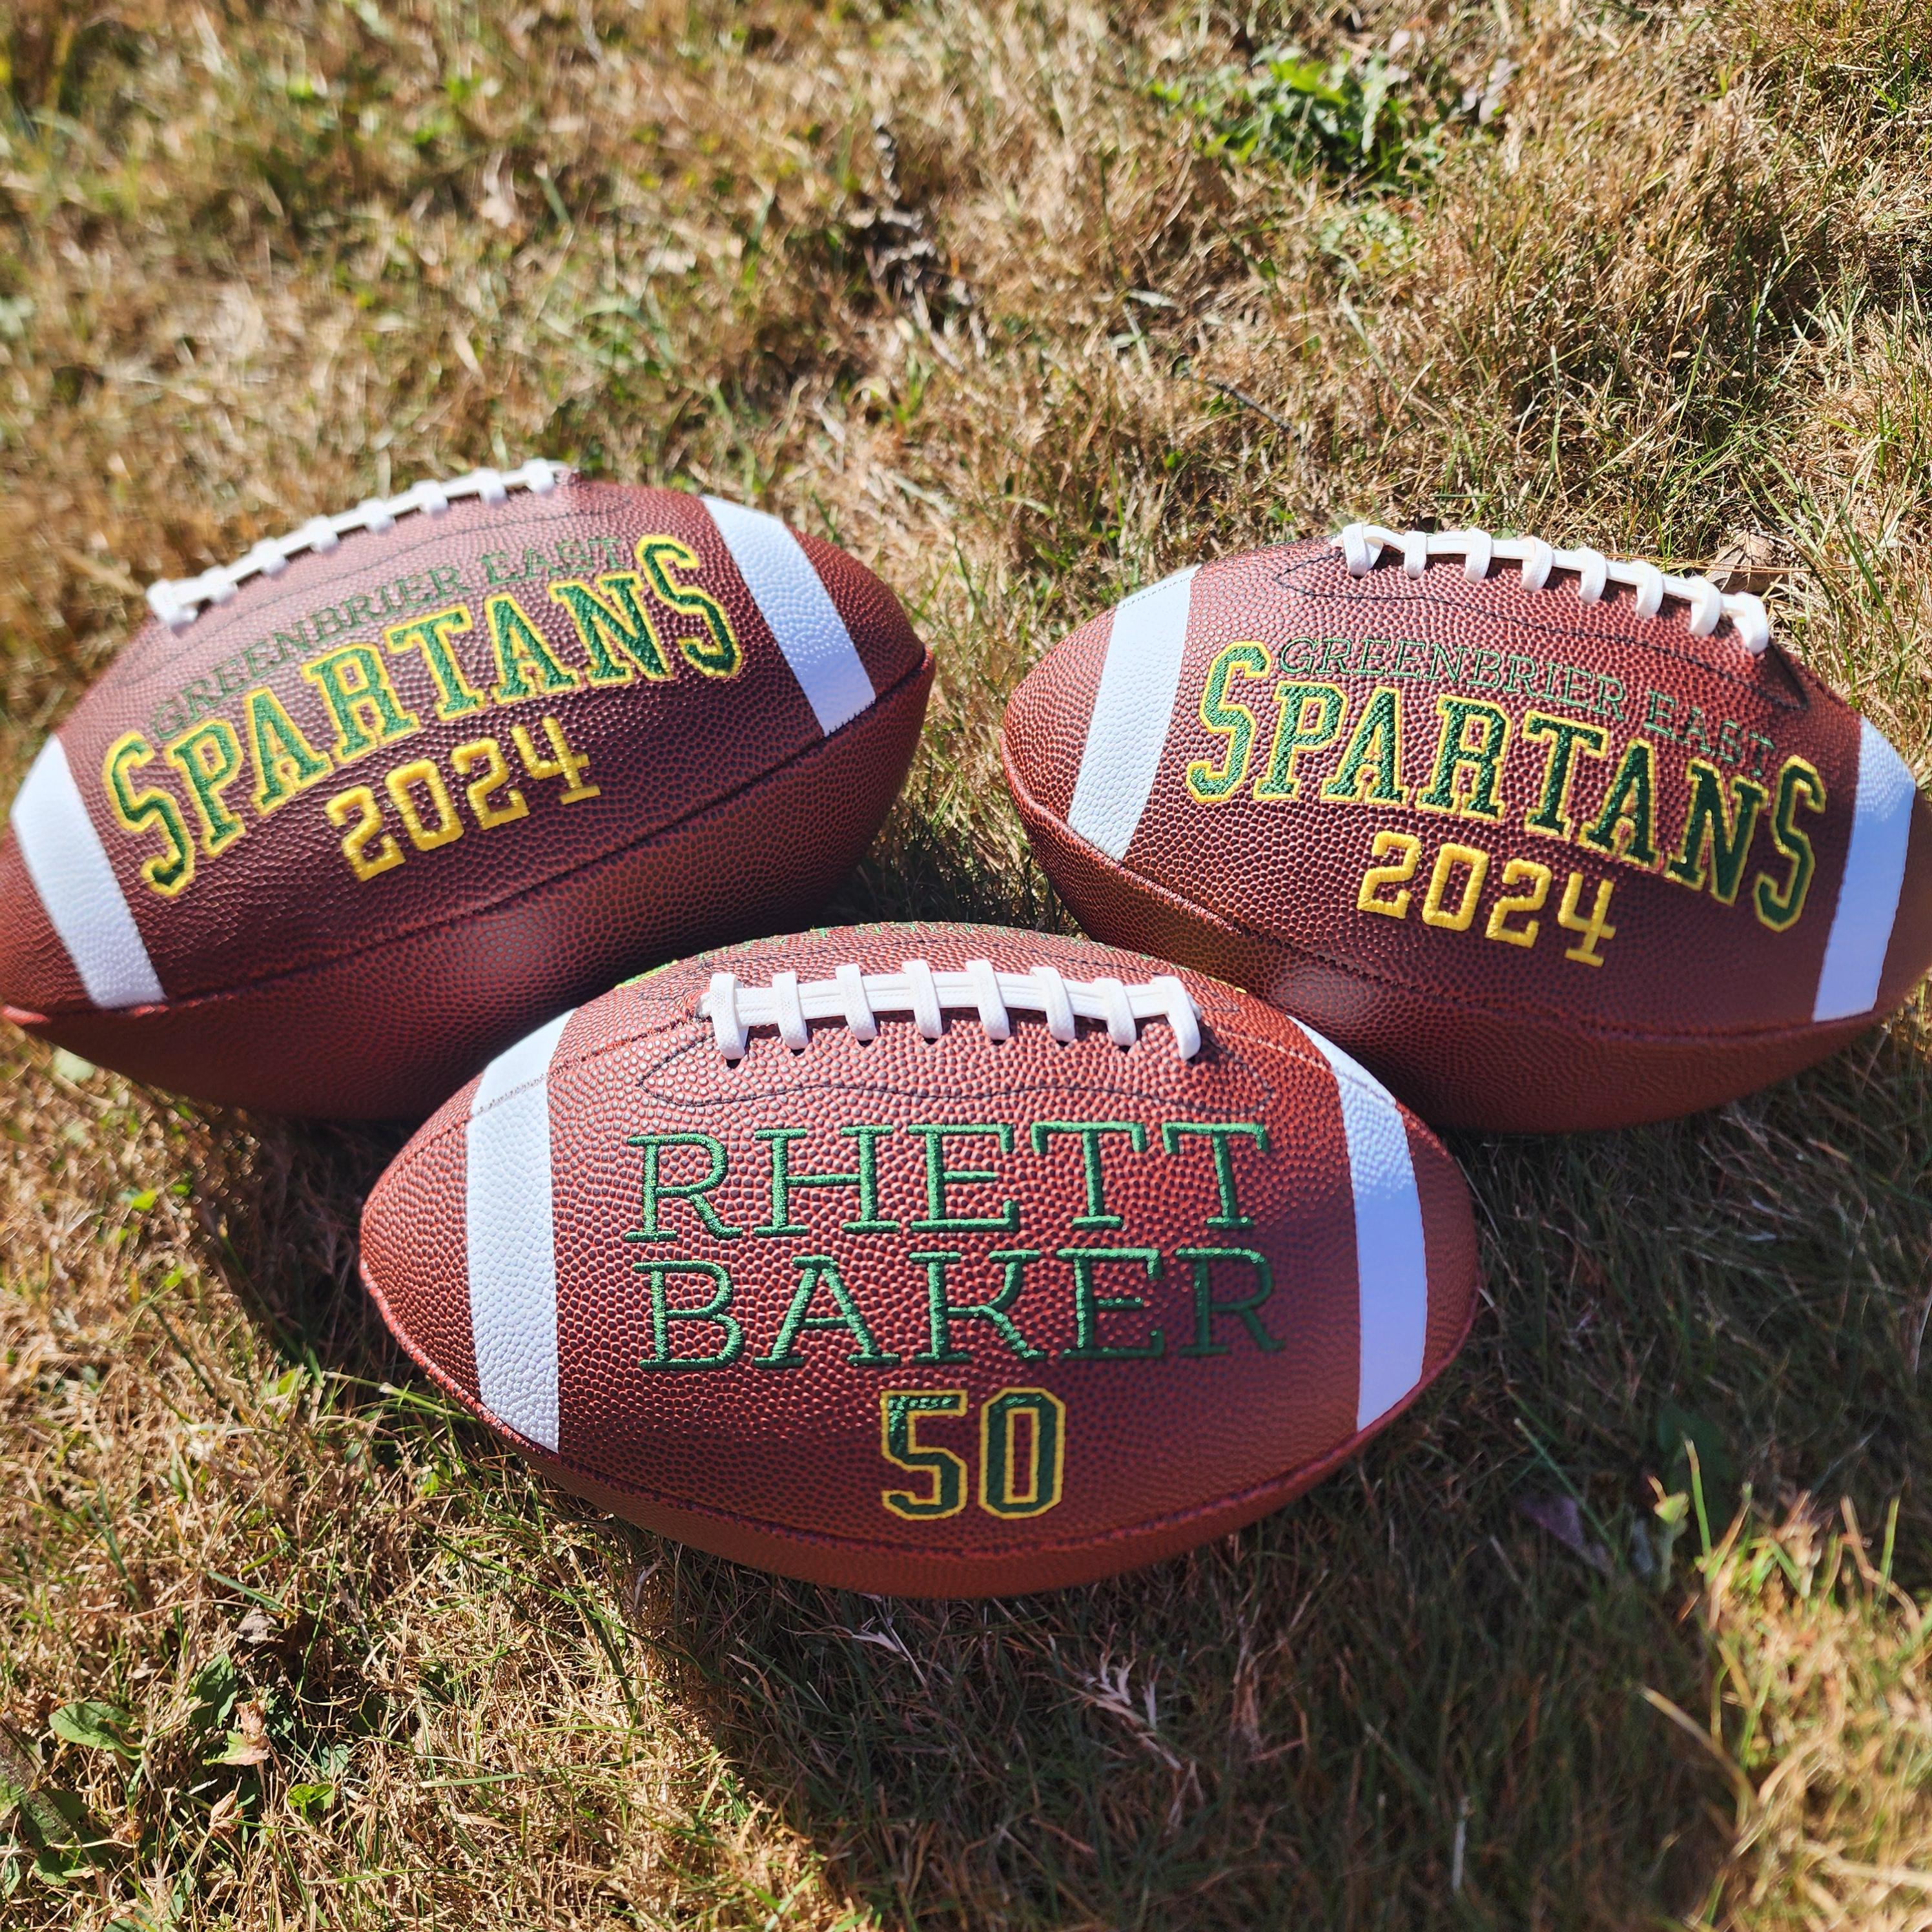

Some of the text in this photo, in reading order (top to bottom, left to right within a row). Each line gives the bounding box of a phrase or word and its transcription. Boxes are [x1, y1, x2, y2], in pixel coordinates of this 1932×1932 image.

[152, 537, 626, 741] GREENBRIER EAST
[1279, 635, 1776, 777] GREENBRIER EAST
[103, 534, 743, 896] SPARTANS
[1186, 640, 1827, 932] SPARTANS
[325, 716, 601, 882] 2024
[1356, 830, 1616, 968] 2024
[624, 1120, 1270, 1244] RHETT
[632, 1248, 1286, 1371] BAKER
[880, 1387, 1066, 1521] 50
